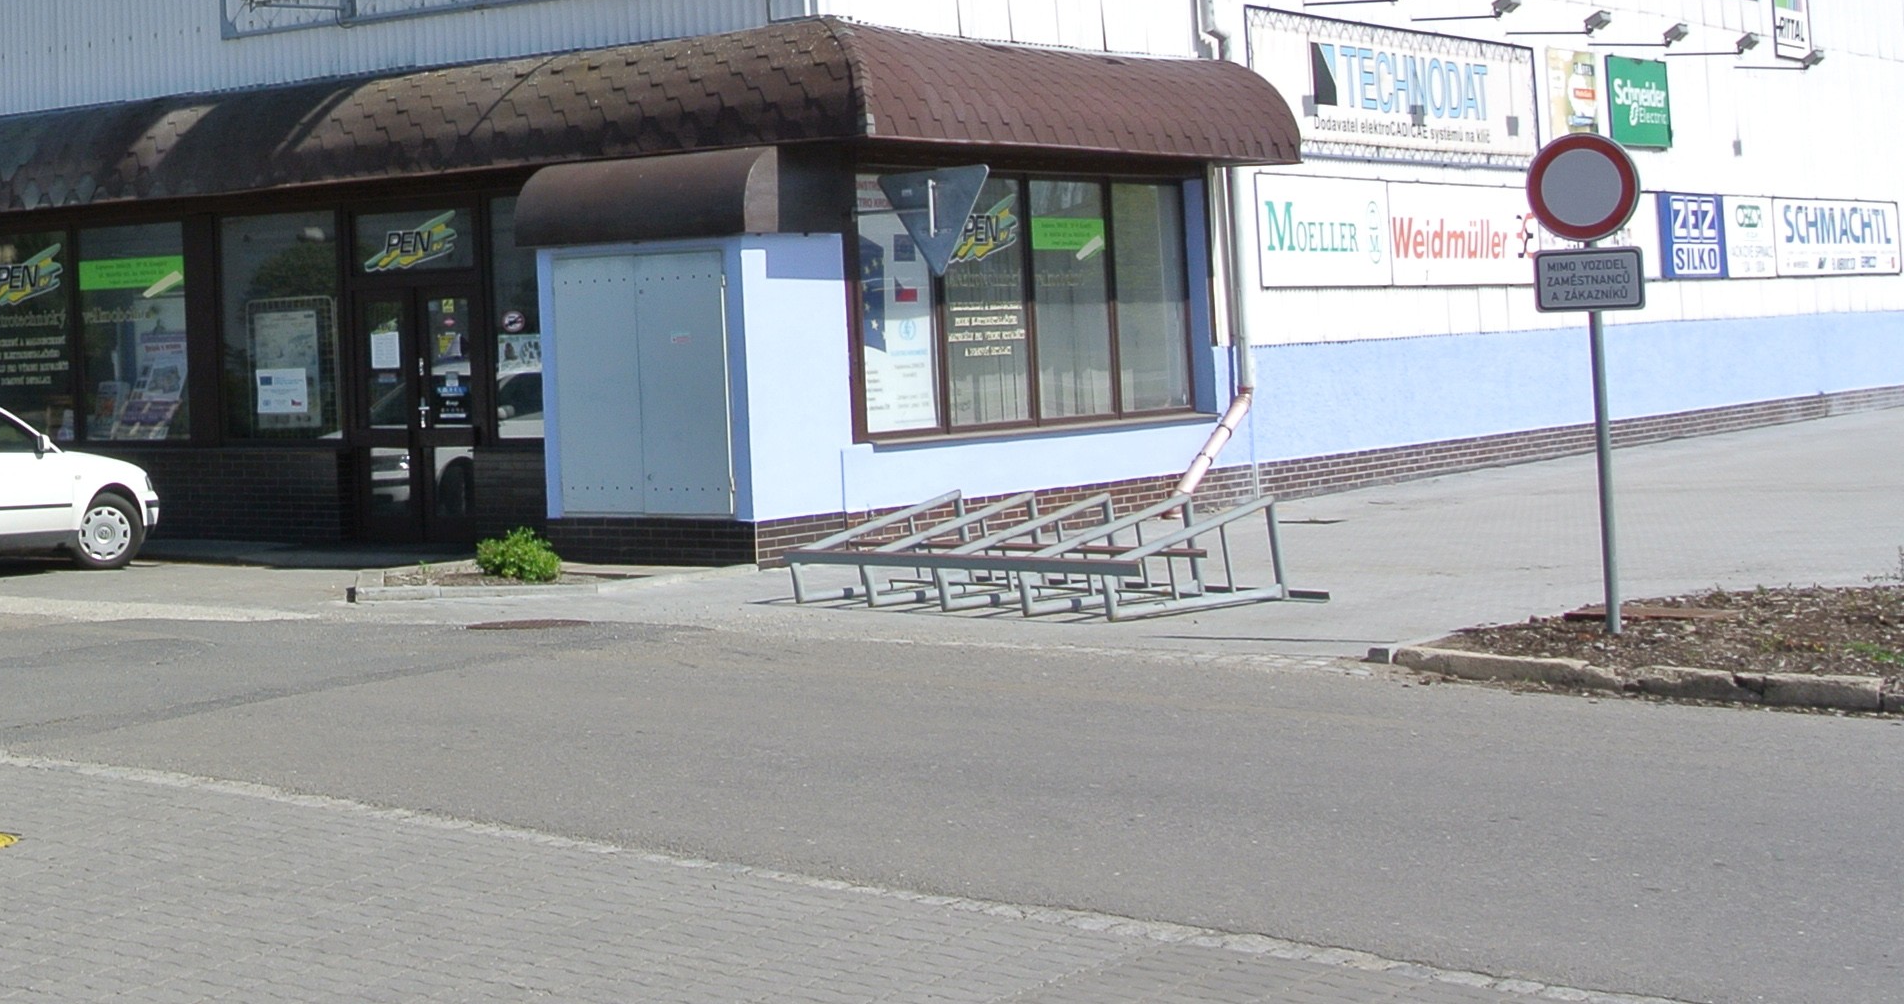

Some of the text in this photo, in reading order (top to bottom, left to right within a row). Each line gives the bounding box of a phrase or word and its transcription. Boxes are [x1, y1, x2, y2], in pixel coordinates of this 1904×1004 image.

[1778, 16, 1805, 42] RITTAL
[1339, 45, 1489, 121] TECHNODAT
[1613, 78, 1666, 108] Schneider
[1313, 113, 1359, 134] Dodavatel
[1465, 130, 1475, 142] na
[1639, 108, 1667, 125] Electric
[962, 214, 999, 243] PEN
[1670, 197, 1718, 243] ZEZ
[1783, 204, 1892, 245] SCHMACHTL
[386, 230, 431, 255] PEN
[1392, 216, 1508, 260] Weidmüller
[1547, 258, 1628, 273] MIMO VOZIDEL
[1675, 246, 1718, 272] SILKO
[1547, 271, 1630, 287] ZAMĚSTNANCŮ
[1551, 284, 1629, 302] A ZÁKAZNÍKŮ
